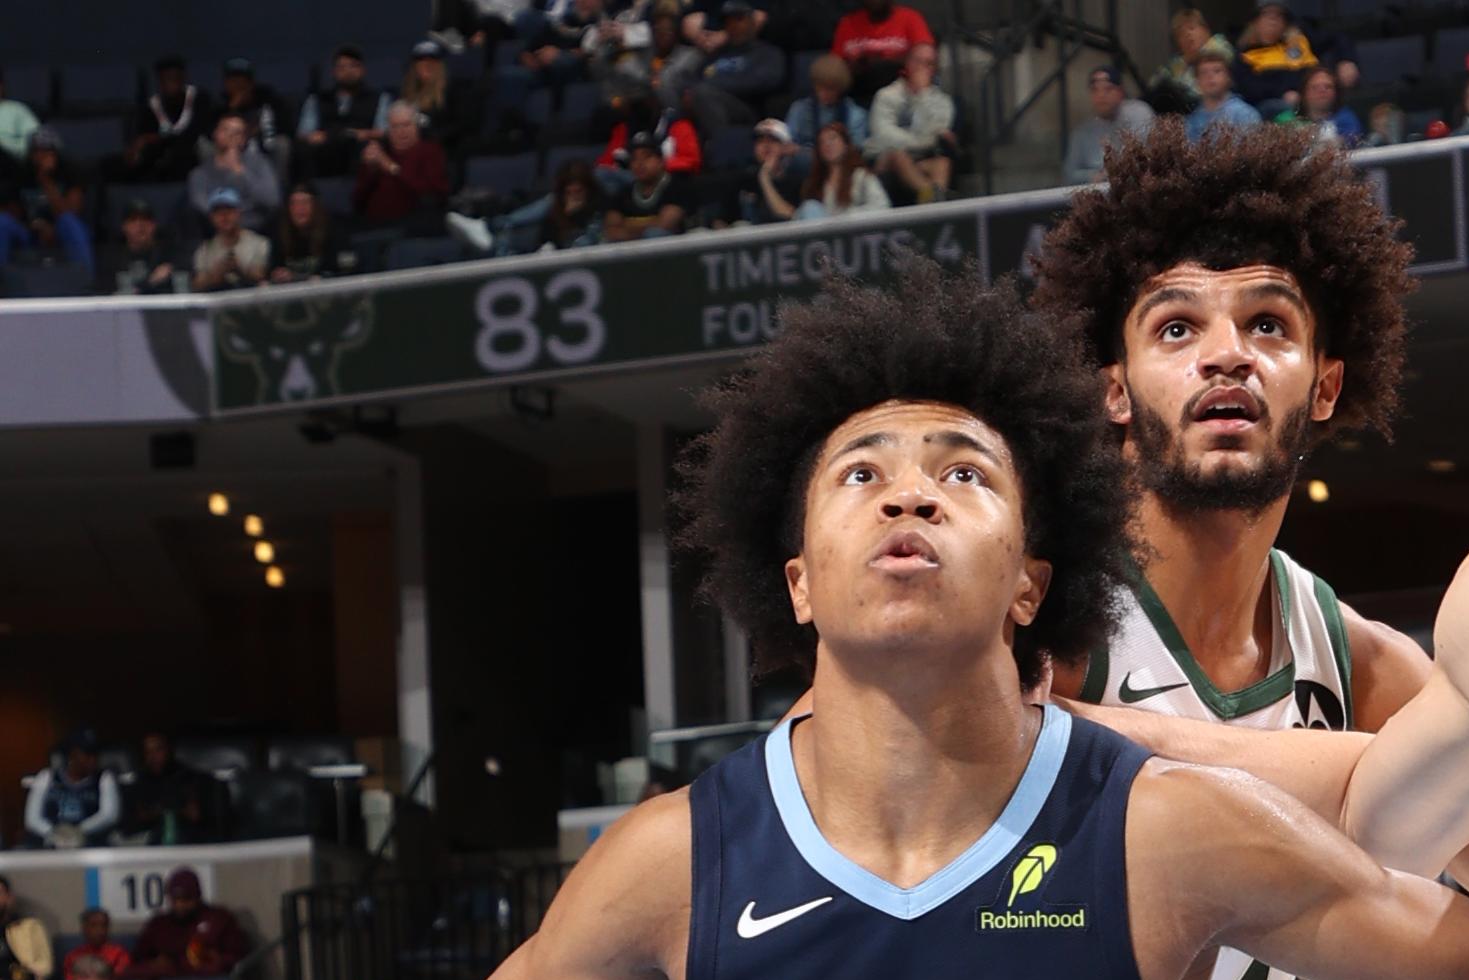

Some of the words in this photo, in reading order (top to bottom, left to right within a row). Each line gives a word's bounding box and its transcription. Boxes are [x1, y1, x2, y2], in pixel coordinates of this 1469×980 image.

[933, 223, 961, 264] 4
[474, 268, 607, 372] 83
[703, 300, 784, 346] FOU
[121, 873, 164, 911] 10
[980, 909, 1084, 929] Robinhood
